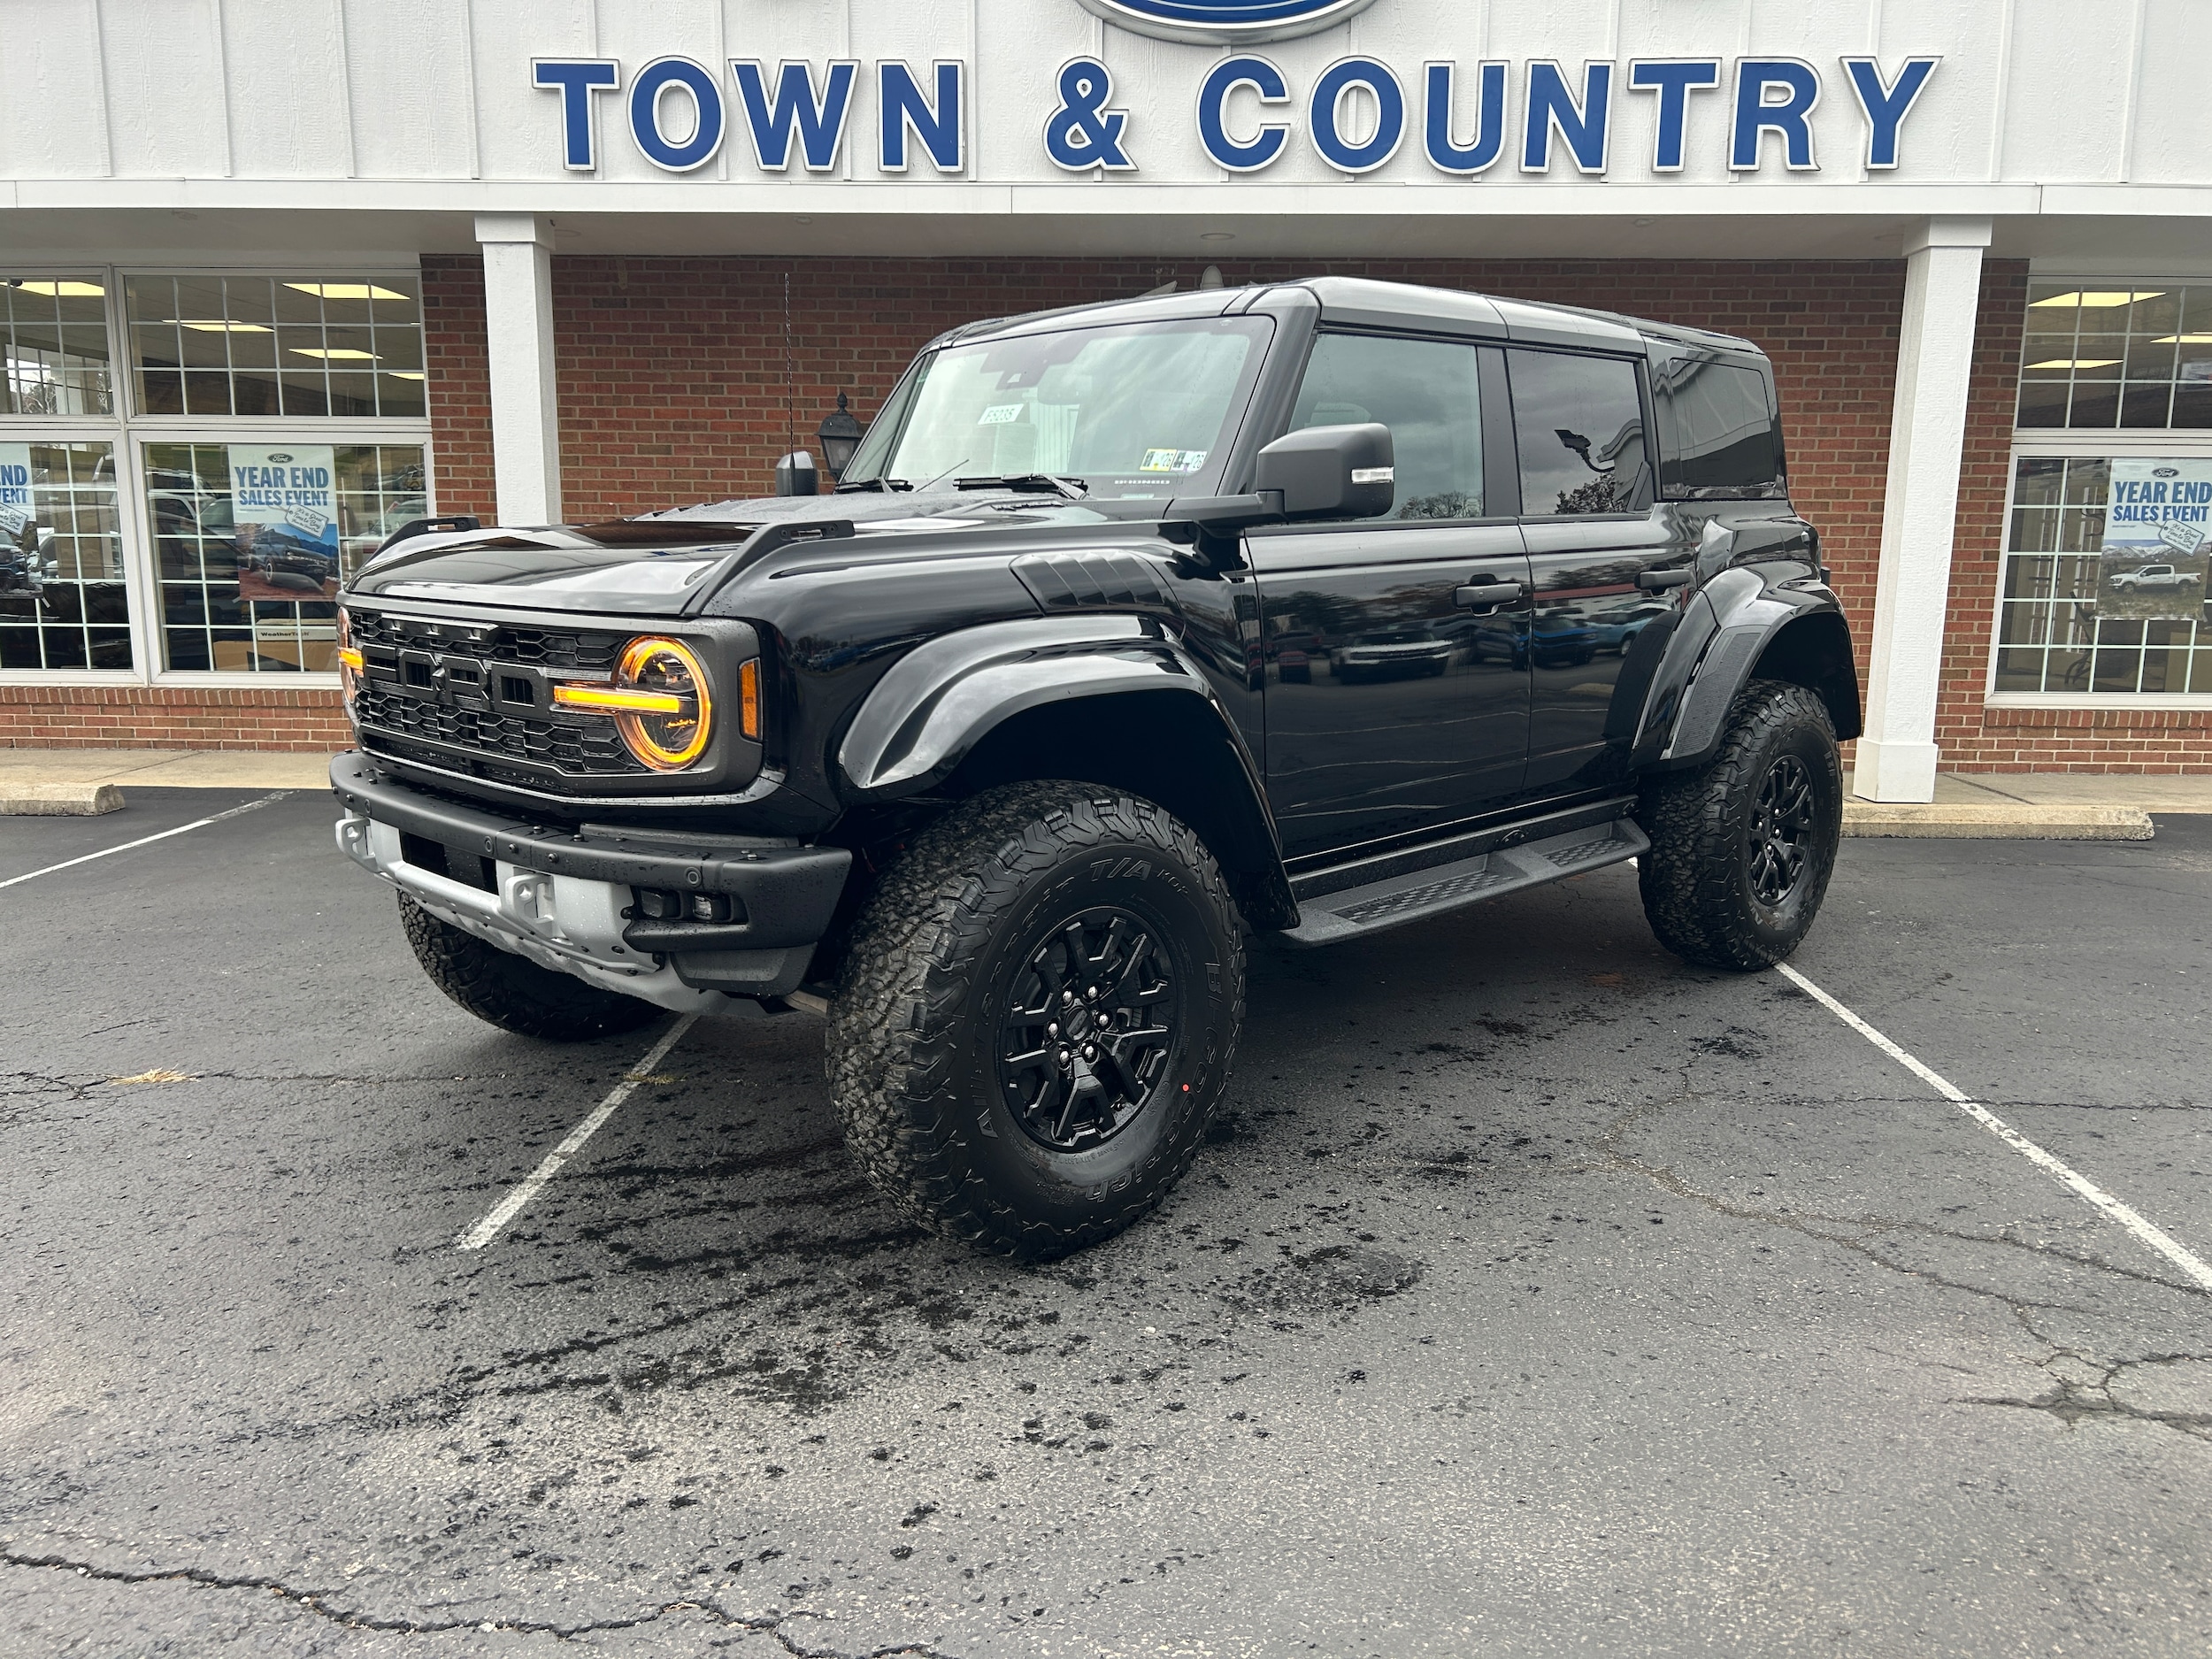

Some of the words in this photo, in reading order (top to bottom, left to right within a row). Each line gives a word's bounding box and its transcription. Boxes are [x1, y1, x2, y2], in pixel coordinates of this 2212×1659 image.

[531, 56, 965, 173] TOWN
[1044, 56, 1140, 172] &
[1194, 54, 1944, 174] COUNTRY
[0, 465, 27, 486] ND
[234, 466, 286, 488] YEAR
[290, 467, 329, 488] END
[238, 489, 282, 506] SALES
[285, 490, 328, 506] EVENT
[2115, 481, 2168, 503] YEAR
[2171, 481, 2212, 503] END
[2113, 505, 2160, 522] SALES
[2162, 505, 2209, 522] EVENT
[362, 642, 550, 722] FORD
